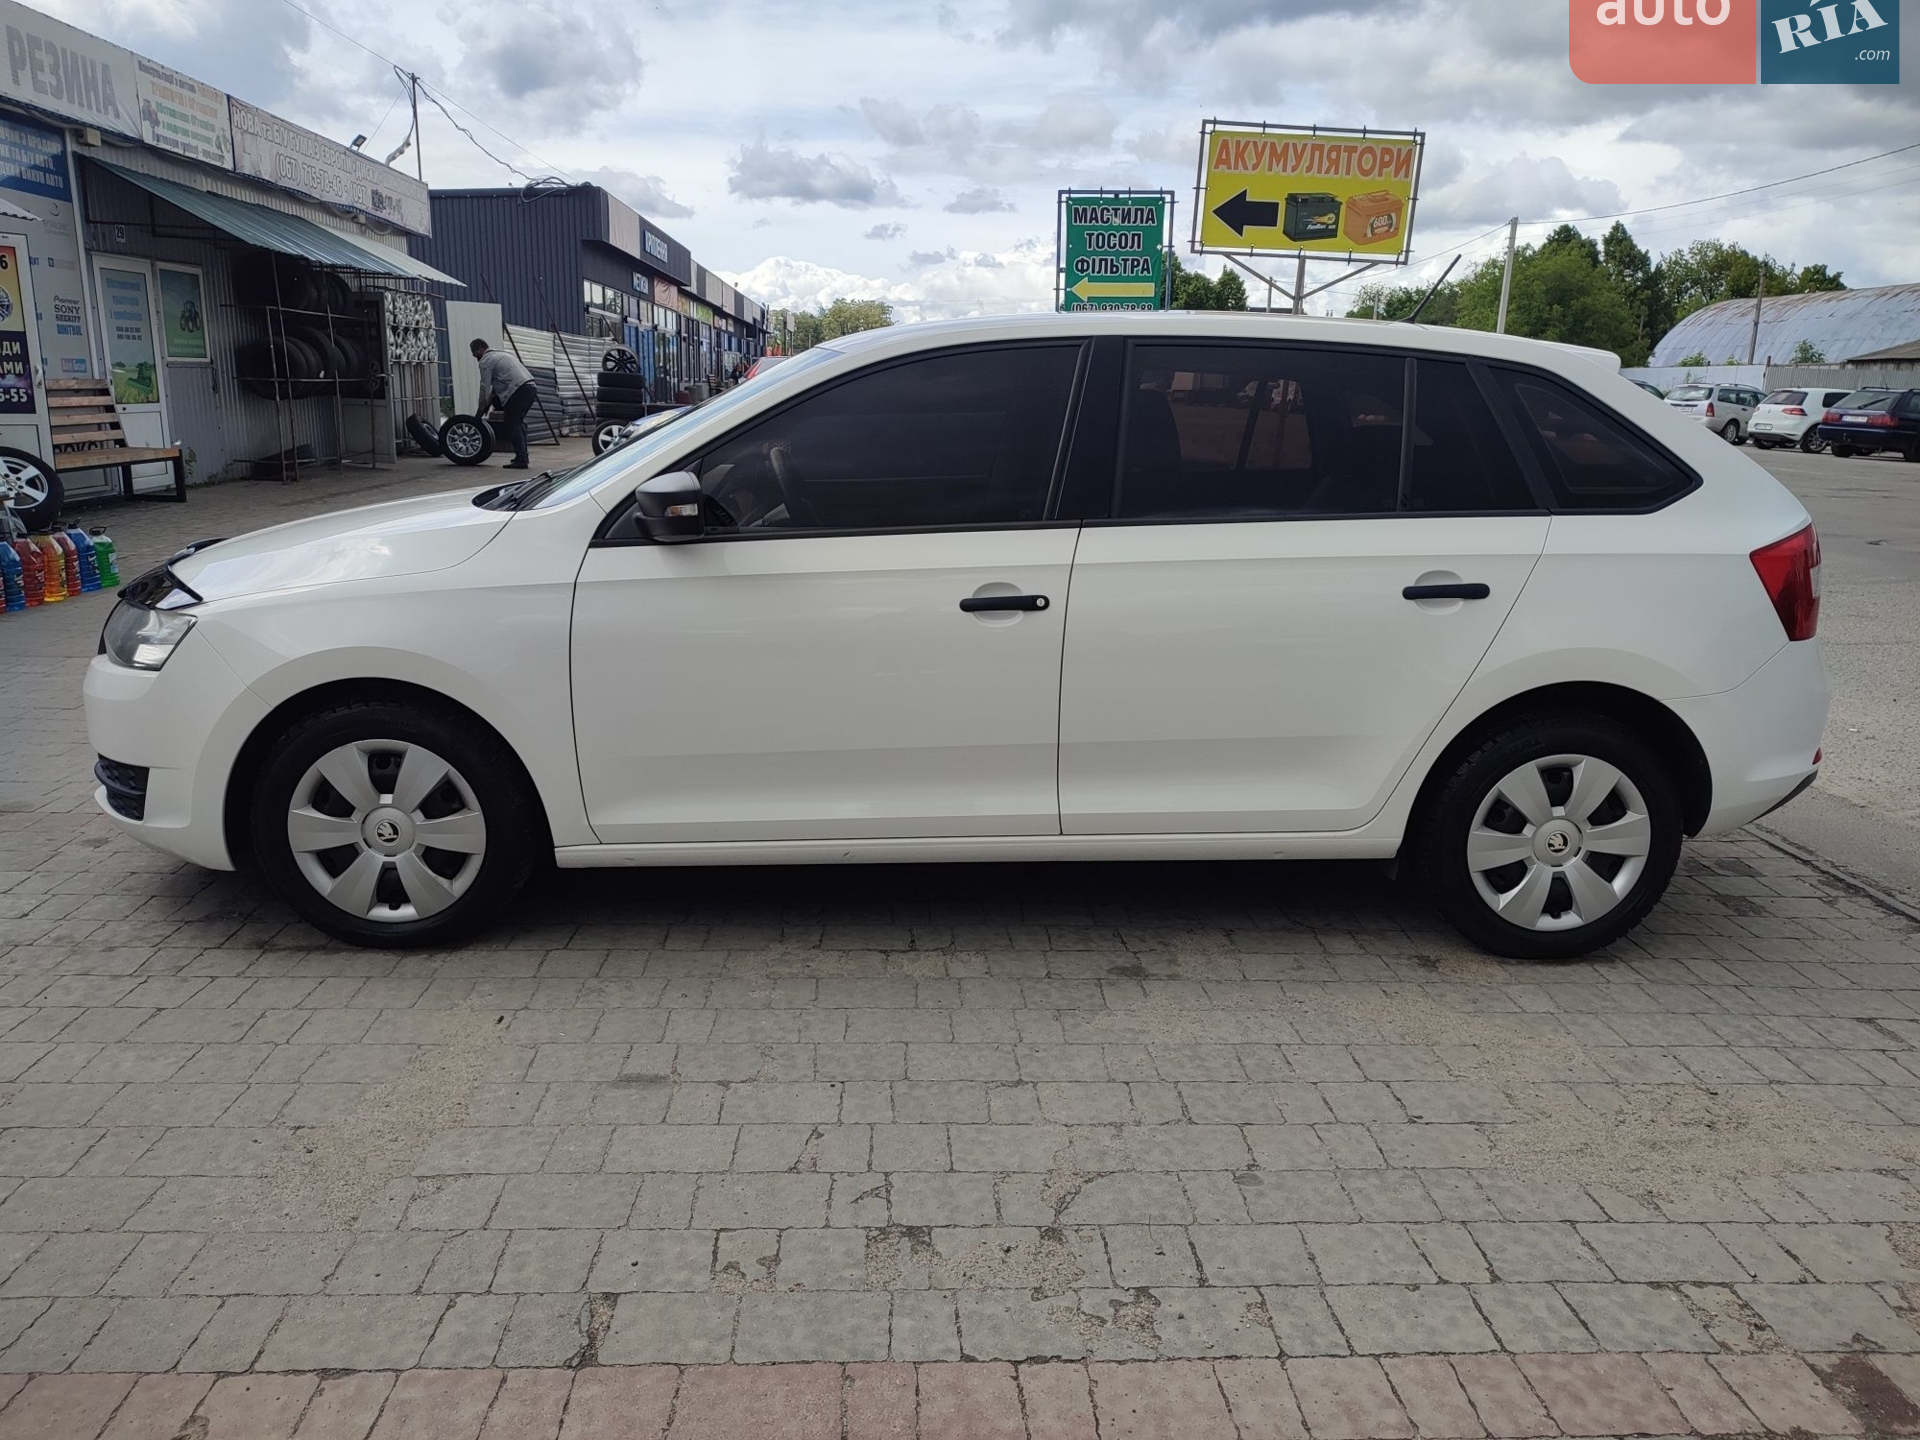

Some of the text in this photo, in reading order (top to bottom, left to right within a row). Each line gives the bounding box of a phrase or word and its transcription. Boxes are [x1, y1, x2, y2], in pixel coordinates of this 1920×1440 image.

[6, 24, 120, 120] РЕЗИНА
[232, 105, 262, 138] НОВА
[261, 121, 274, 142] та
[273, 123, 288, 148] Б/У
[289, 131, 312, 159] ГУМА
[321, 144, 353, 175] ЄВРОПИ
[1213, 137, 1413, 180] АКУМУЛЯТОРИ
[46, 172, 64, 188] АВТО
[276, 151, 301, 186] (067)
[302, 162, 344, 198] 715-78-46
[1073, 206, 1157, 226] МАСТИЛА
[116, 226, 125, 239] 29
[1085, 232, 1142, 251] ТОСОЛ
[1074, 257, 1152, 276] ФІЛЬТРА
[54, 304, 80, 315] SONY
[0, 341, 21, 356] ДИ
